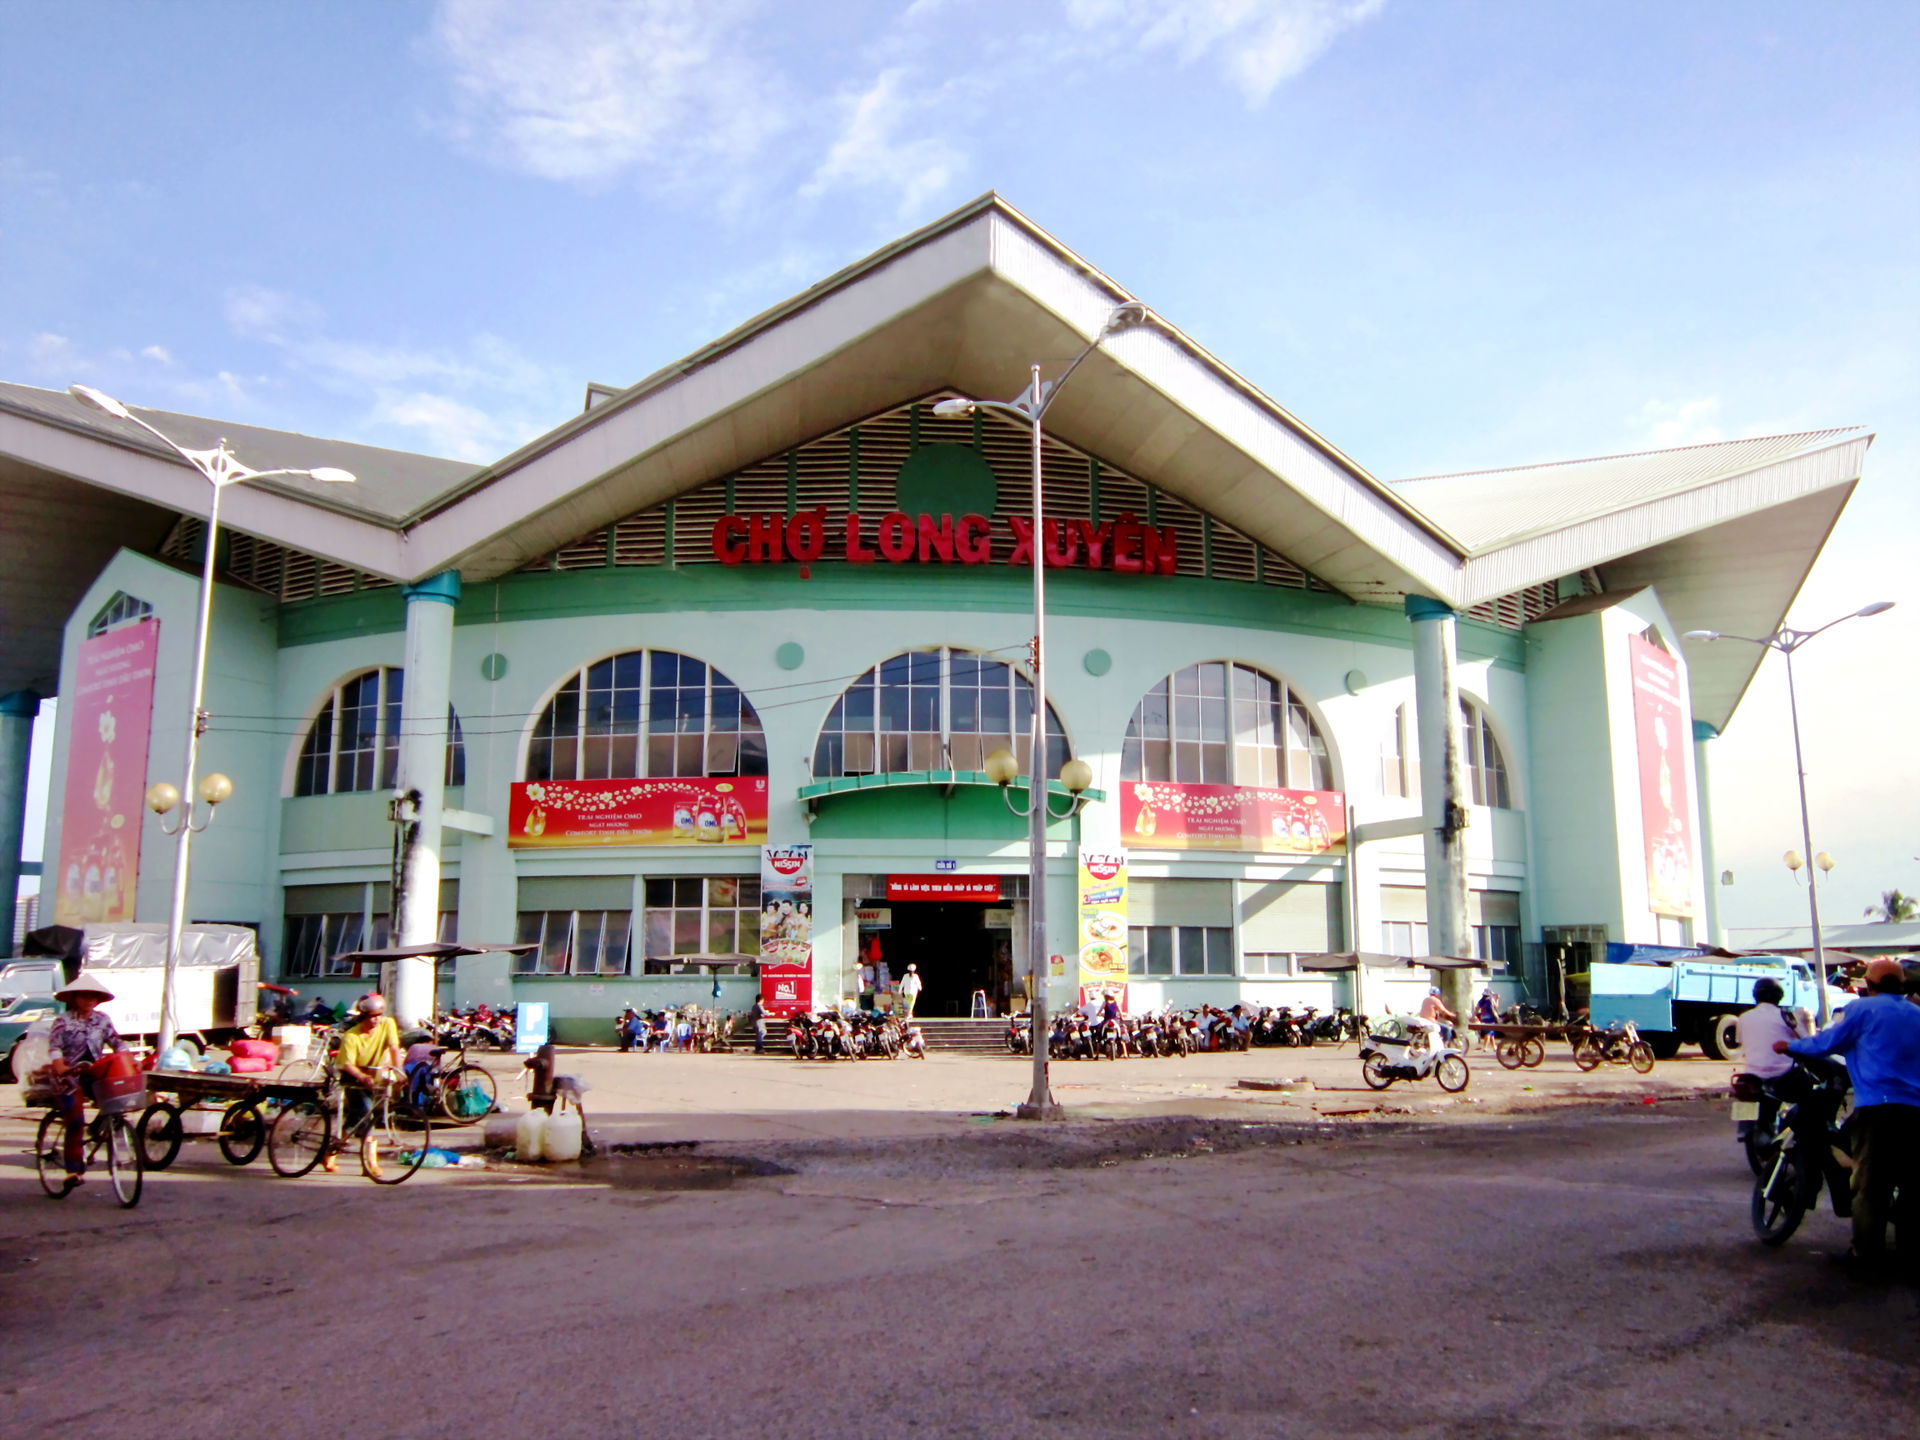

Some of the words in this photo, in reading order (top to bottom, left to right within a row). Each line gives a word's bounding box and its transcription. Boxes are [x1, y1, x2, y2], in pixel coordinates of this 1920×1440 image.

[712, 505, 827, 579] CHỢ
[846, 511, 991, 566] LONG
[1007, 511, 1178, 576] XUYÊN
[774, 858, 801, 869] NISSIN
